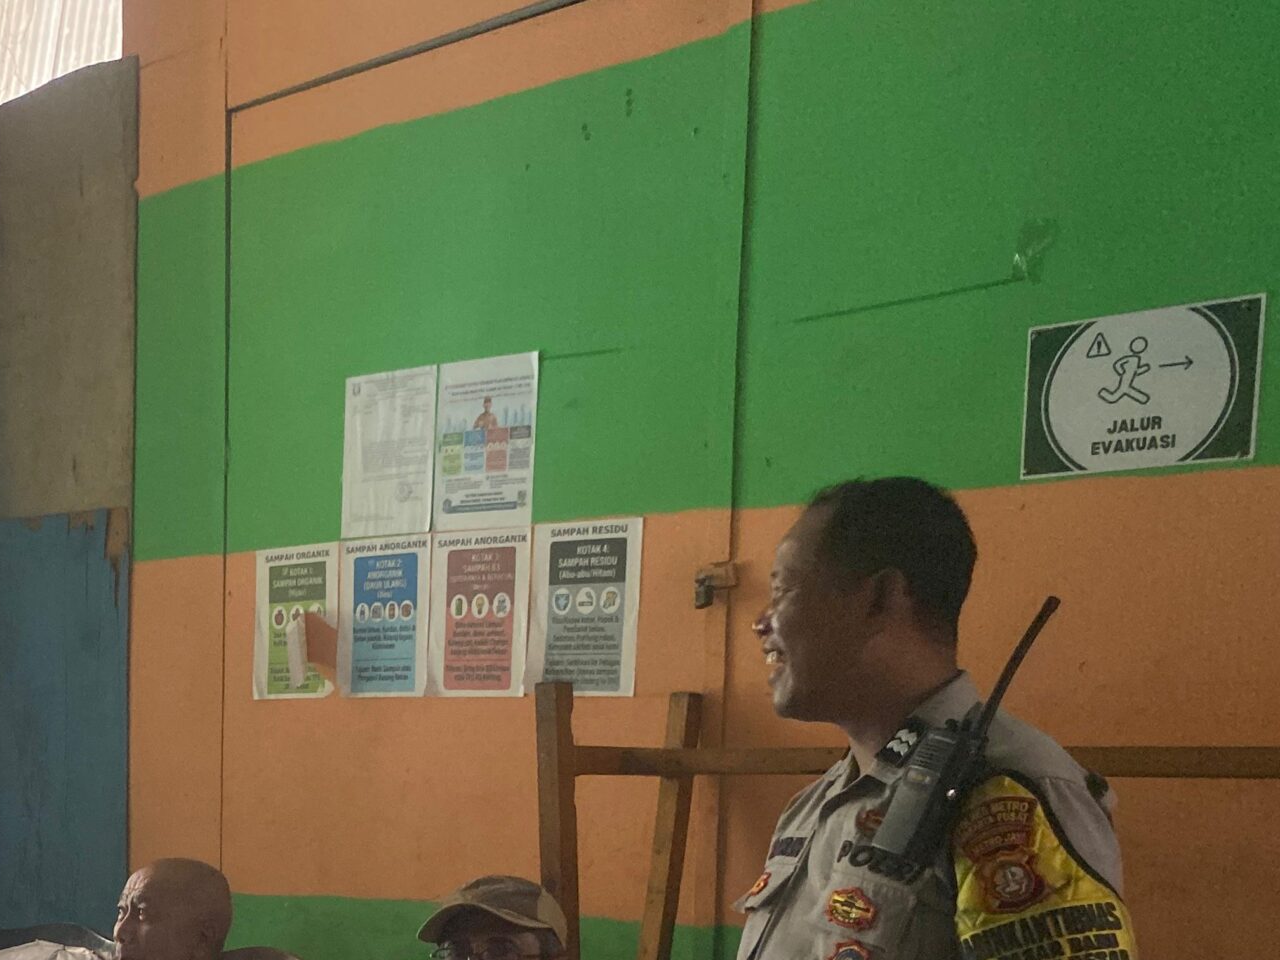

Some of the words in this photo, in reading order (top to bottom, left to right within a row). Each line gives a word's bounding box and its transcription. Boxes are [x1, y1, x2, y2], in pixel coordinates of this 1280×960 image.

[1106, 415, 1163, 435] JALUR
[1090, 434, 1177, 456] EVAKUASI
[550, 527, 589, 537] SAMPAH
[591, 524, 628, 535] RESIDU
[345, 545, 377, 555] SAMPAH
[379, 540, 428, 551] ANORGANIK
[437, 537, 473, 548] SAMPAH
[474, 534, 528, 546] ANORGANIK
[265, 554, 294, 563] SAMPAH
[296, 549, 330, 560] ORGANIK
[576, 544, 601, 555] KOTAK
[558, 557, 590, 568] SAMPAH
[590, 556, 618, 567] RESIDU
